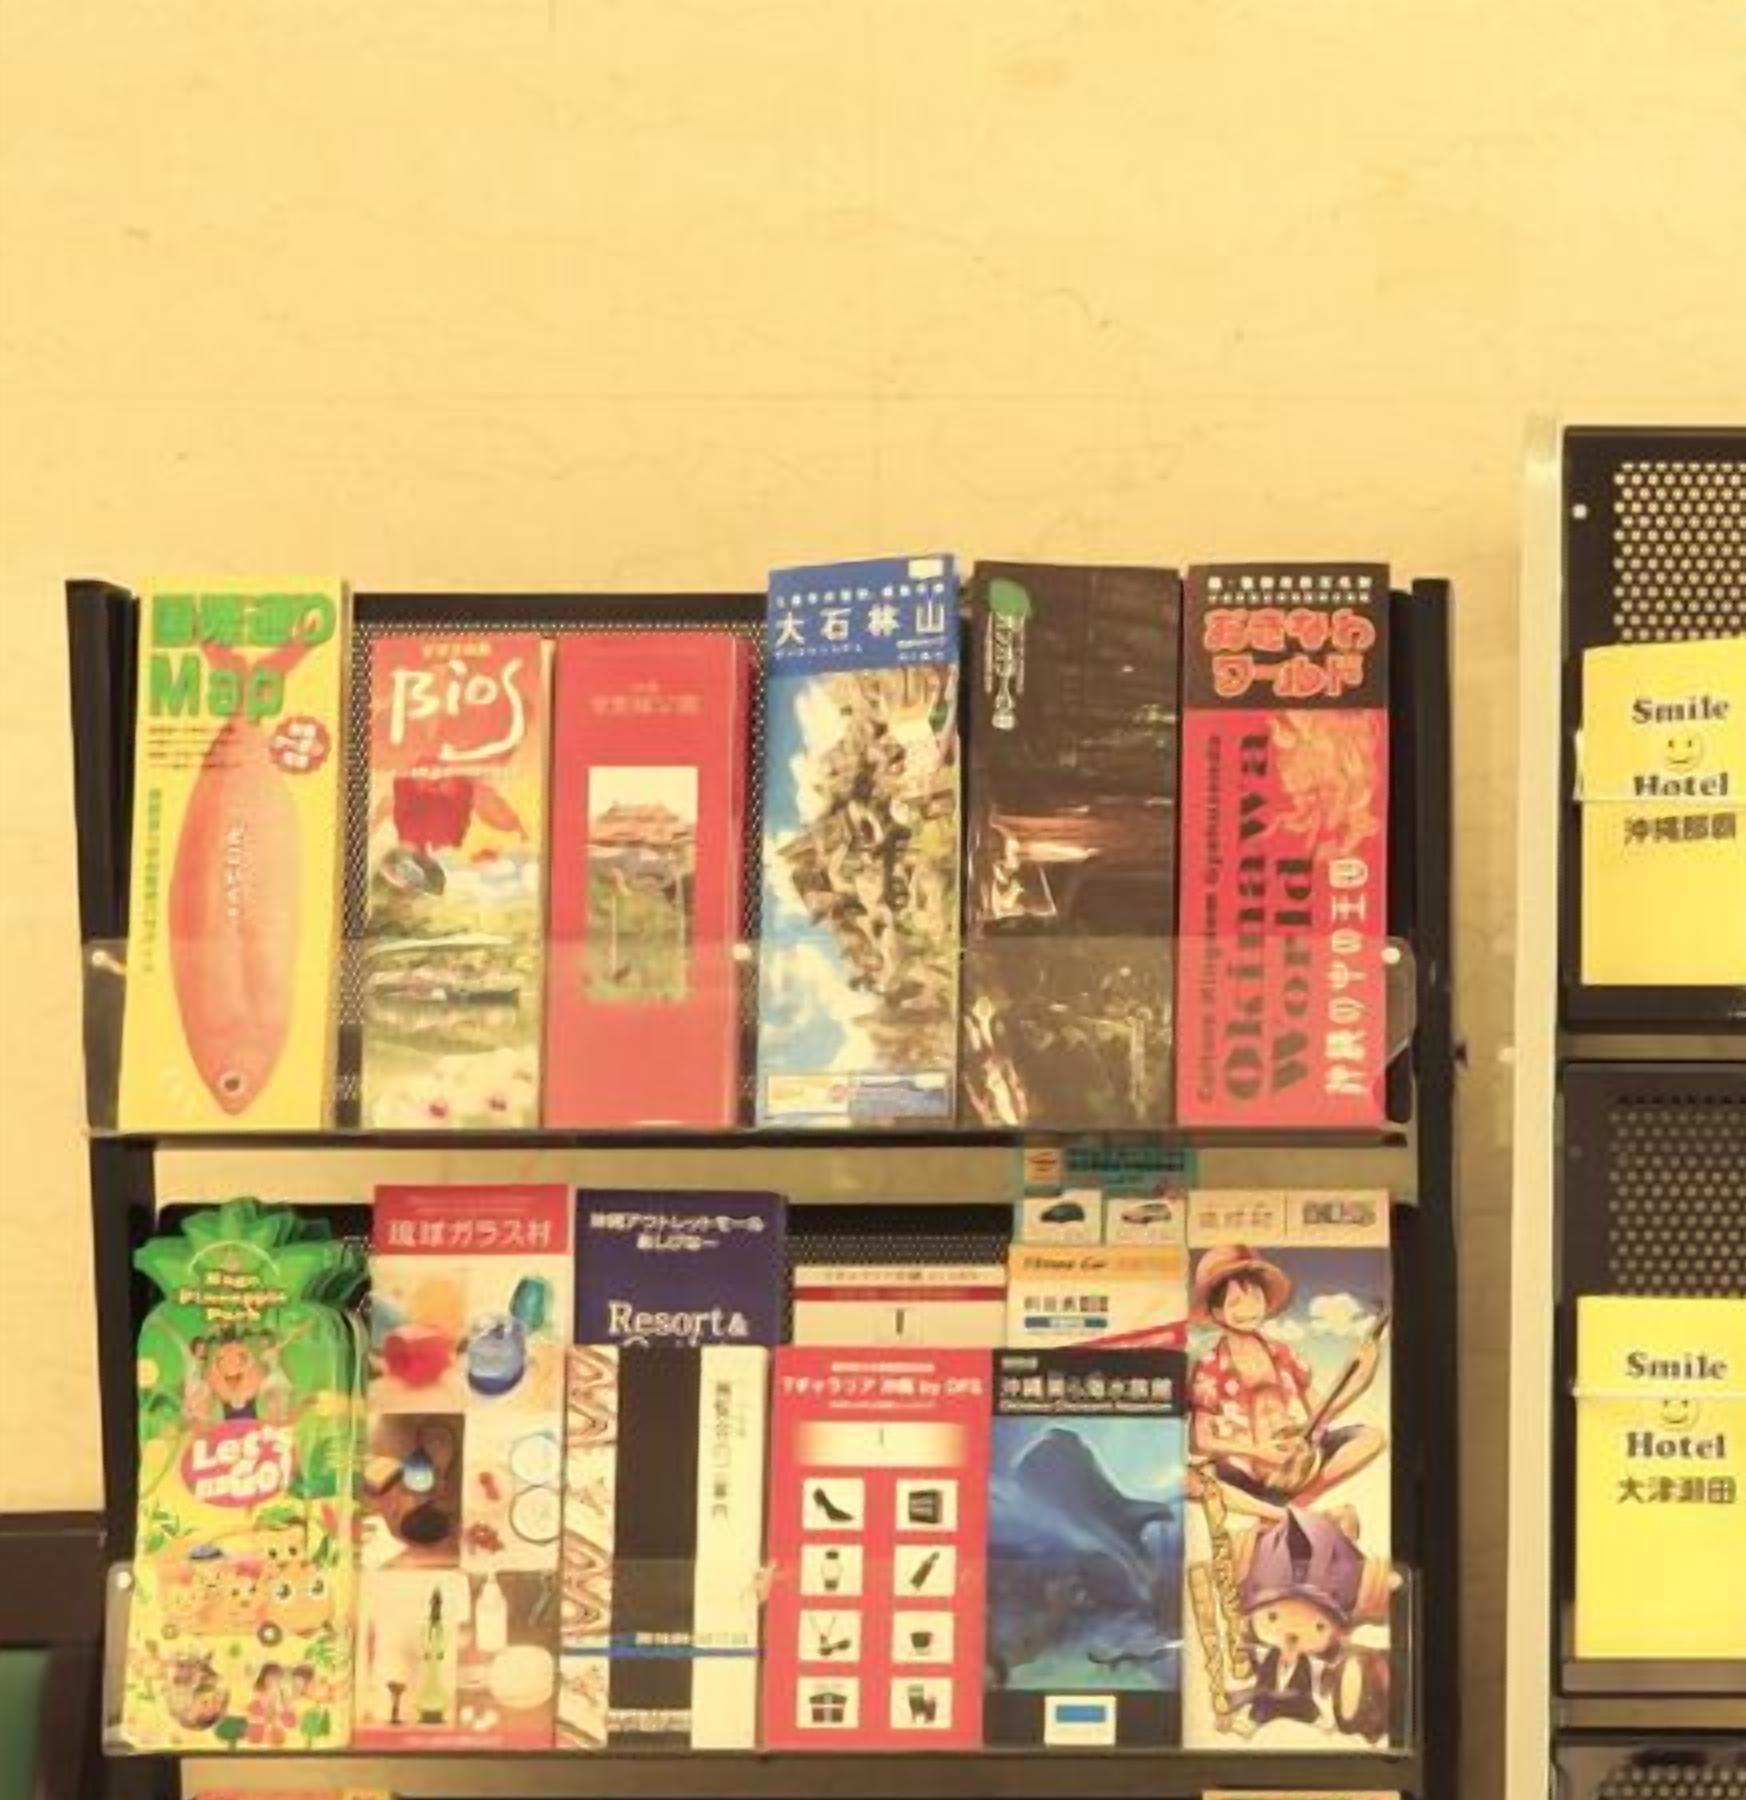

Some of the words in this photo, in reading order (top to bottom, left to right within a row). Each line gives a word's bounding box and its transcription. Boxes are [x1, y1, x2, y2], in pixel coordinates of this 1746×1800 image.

[776, 598, 944, 646] 大石林山
[1632, 696, 1730, 726] Smile
[1633, 772, 1730, 798] Hotel
[1224, 735, 1269, 1100] Okinawa
[1270, 858, 1313, 1092] World
[1627, 1352, 1729, 1381] Smile
[1627, 1432, 1727, 1461] Hotel
